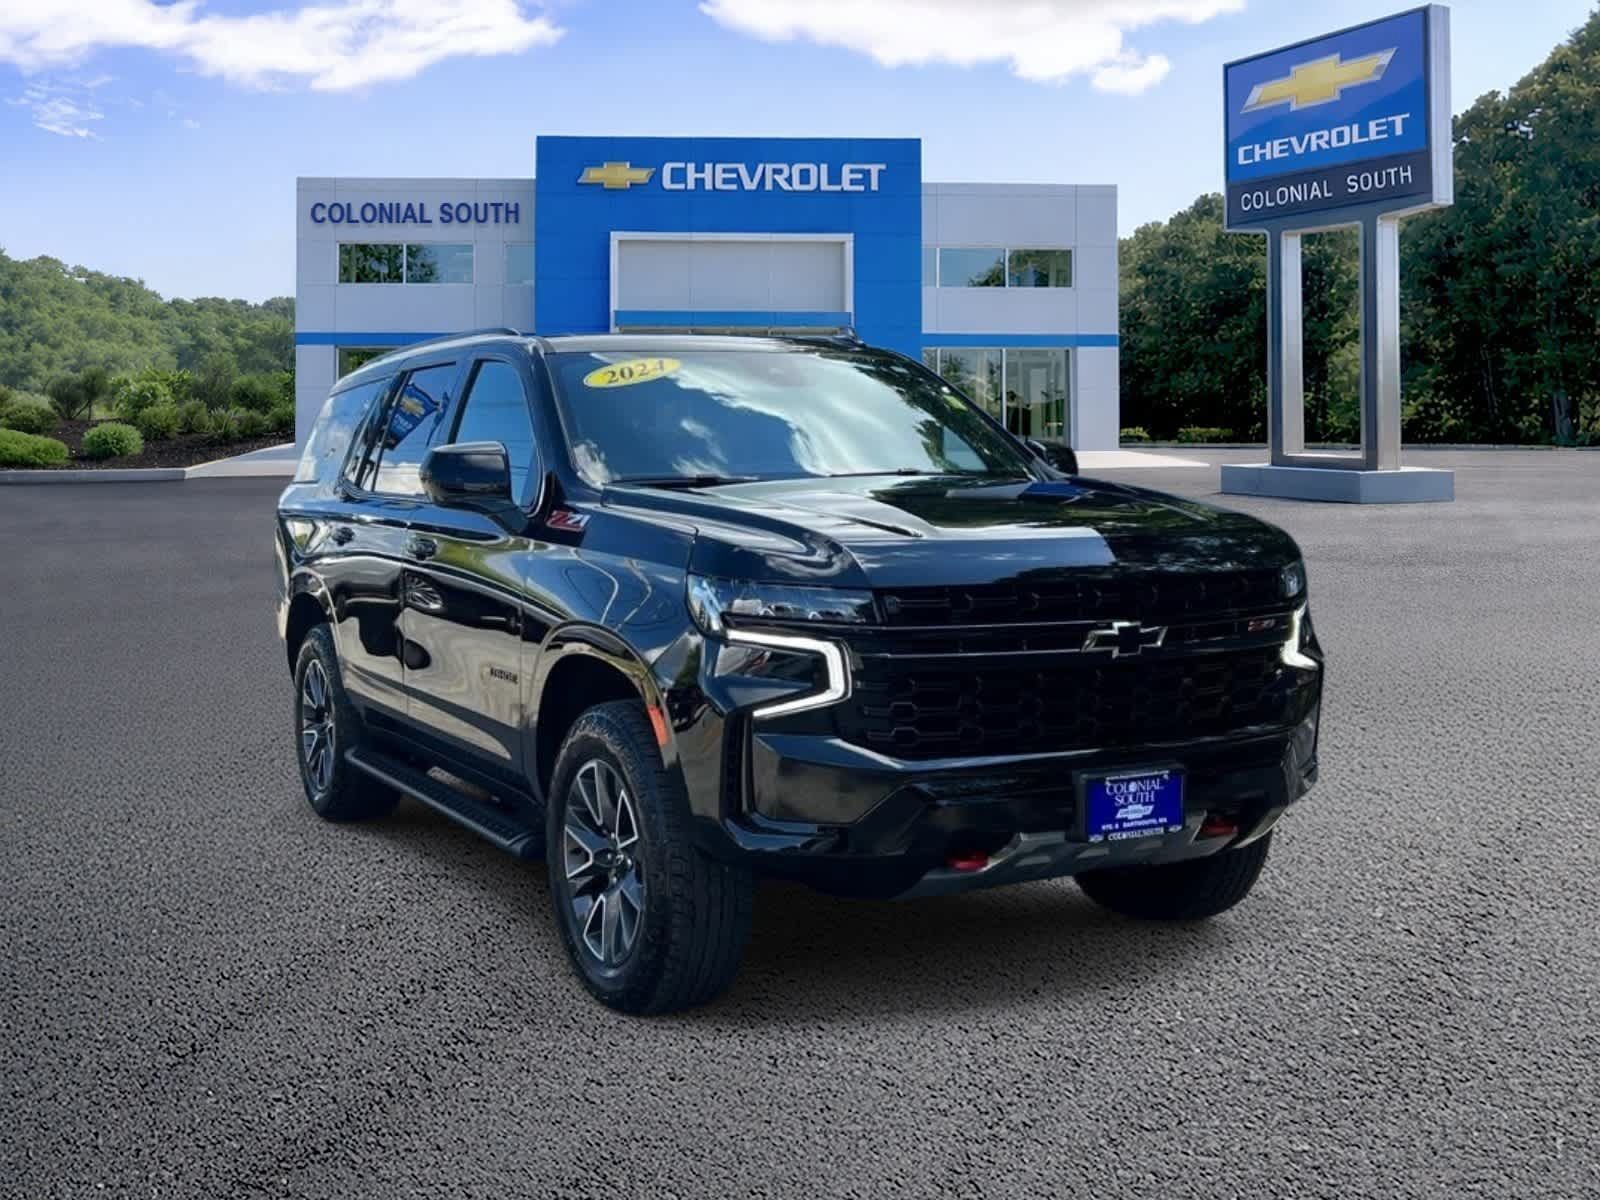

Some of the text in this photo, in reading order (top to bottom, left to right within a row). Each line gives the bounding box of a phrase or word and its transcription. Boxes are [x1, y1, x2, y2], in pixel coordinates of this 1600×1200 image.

[1237, 113, 1410, 165] CHEVROLET
[661, 162, 887, 192] CHEVROLET
[1240, 165, 1413, 211] COLONIAL SOUTH
[310, 202, 520, 224] COLONIAL SOUTH
[607, 360, 665, 384] 2024
[1105, 778, 1164, 796] COLONIAL
[1114, 790, 1155, 806] SOUTH
